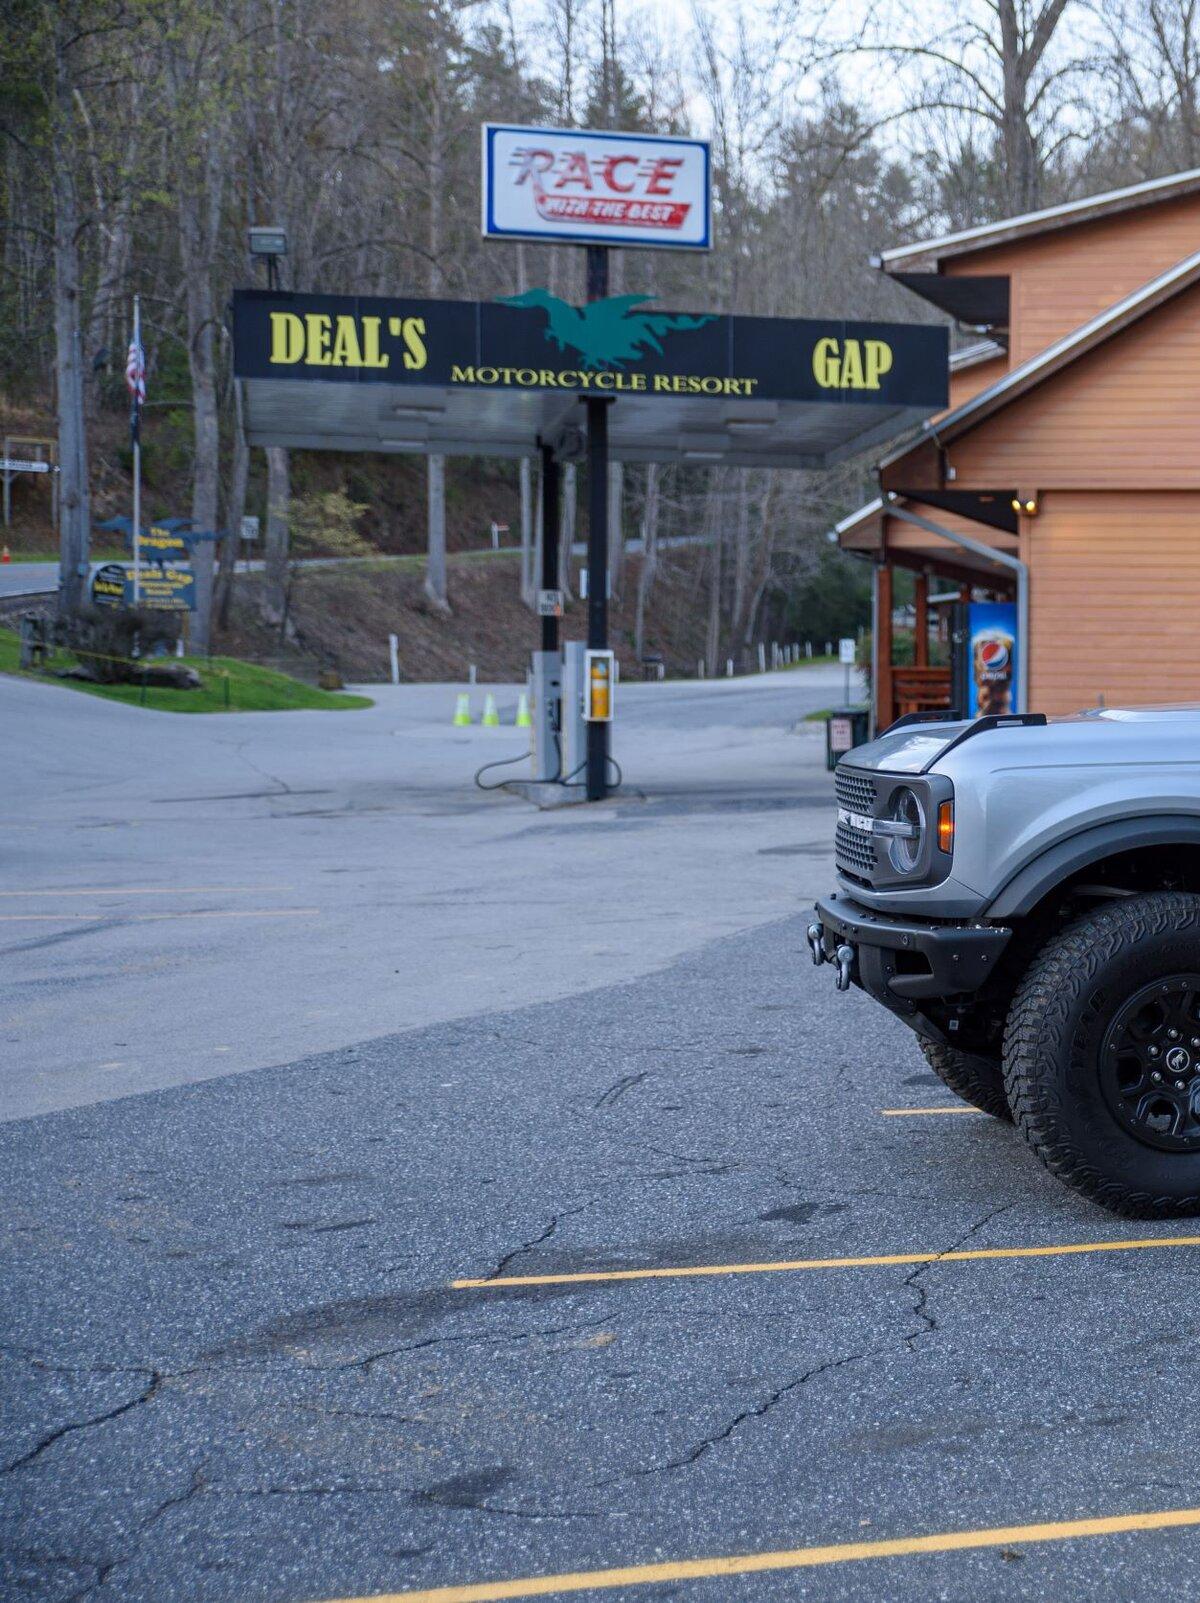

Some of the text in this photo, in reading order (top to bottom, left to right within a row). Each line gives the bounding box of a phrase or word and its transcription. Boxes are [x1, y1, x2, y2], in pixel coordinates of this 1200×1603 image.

[508, 147, 685, 195] RACE
[546, 197, 675, 221] WITH THE BEST
[269, 311, 893, 390] DEAL'S GAP
[451, 364, 758, 396] MOTORCYCLE RESORT
